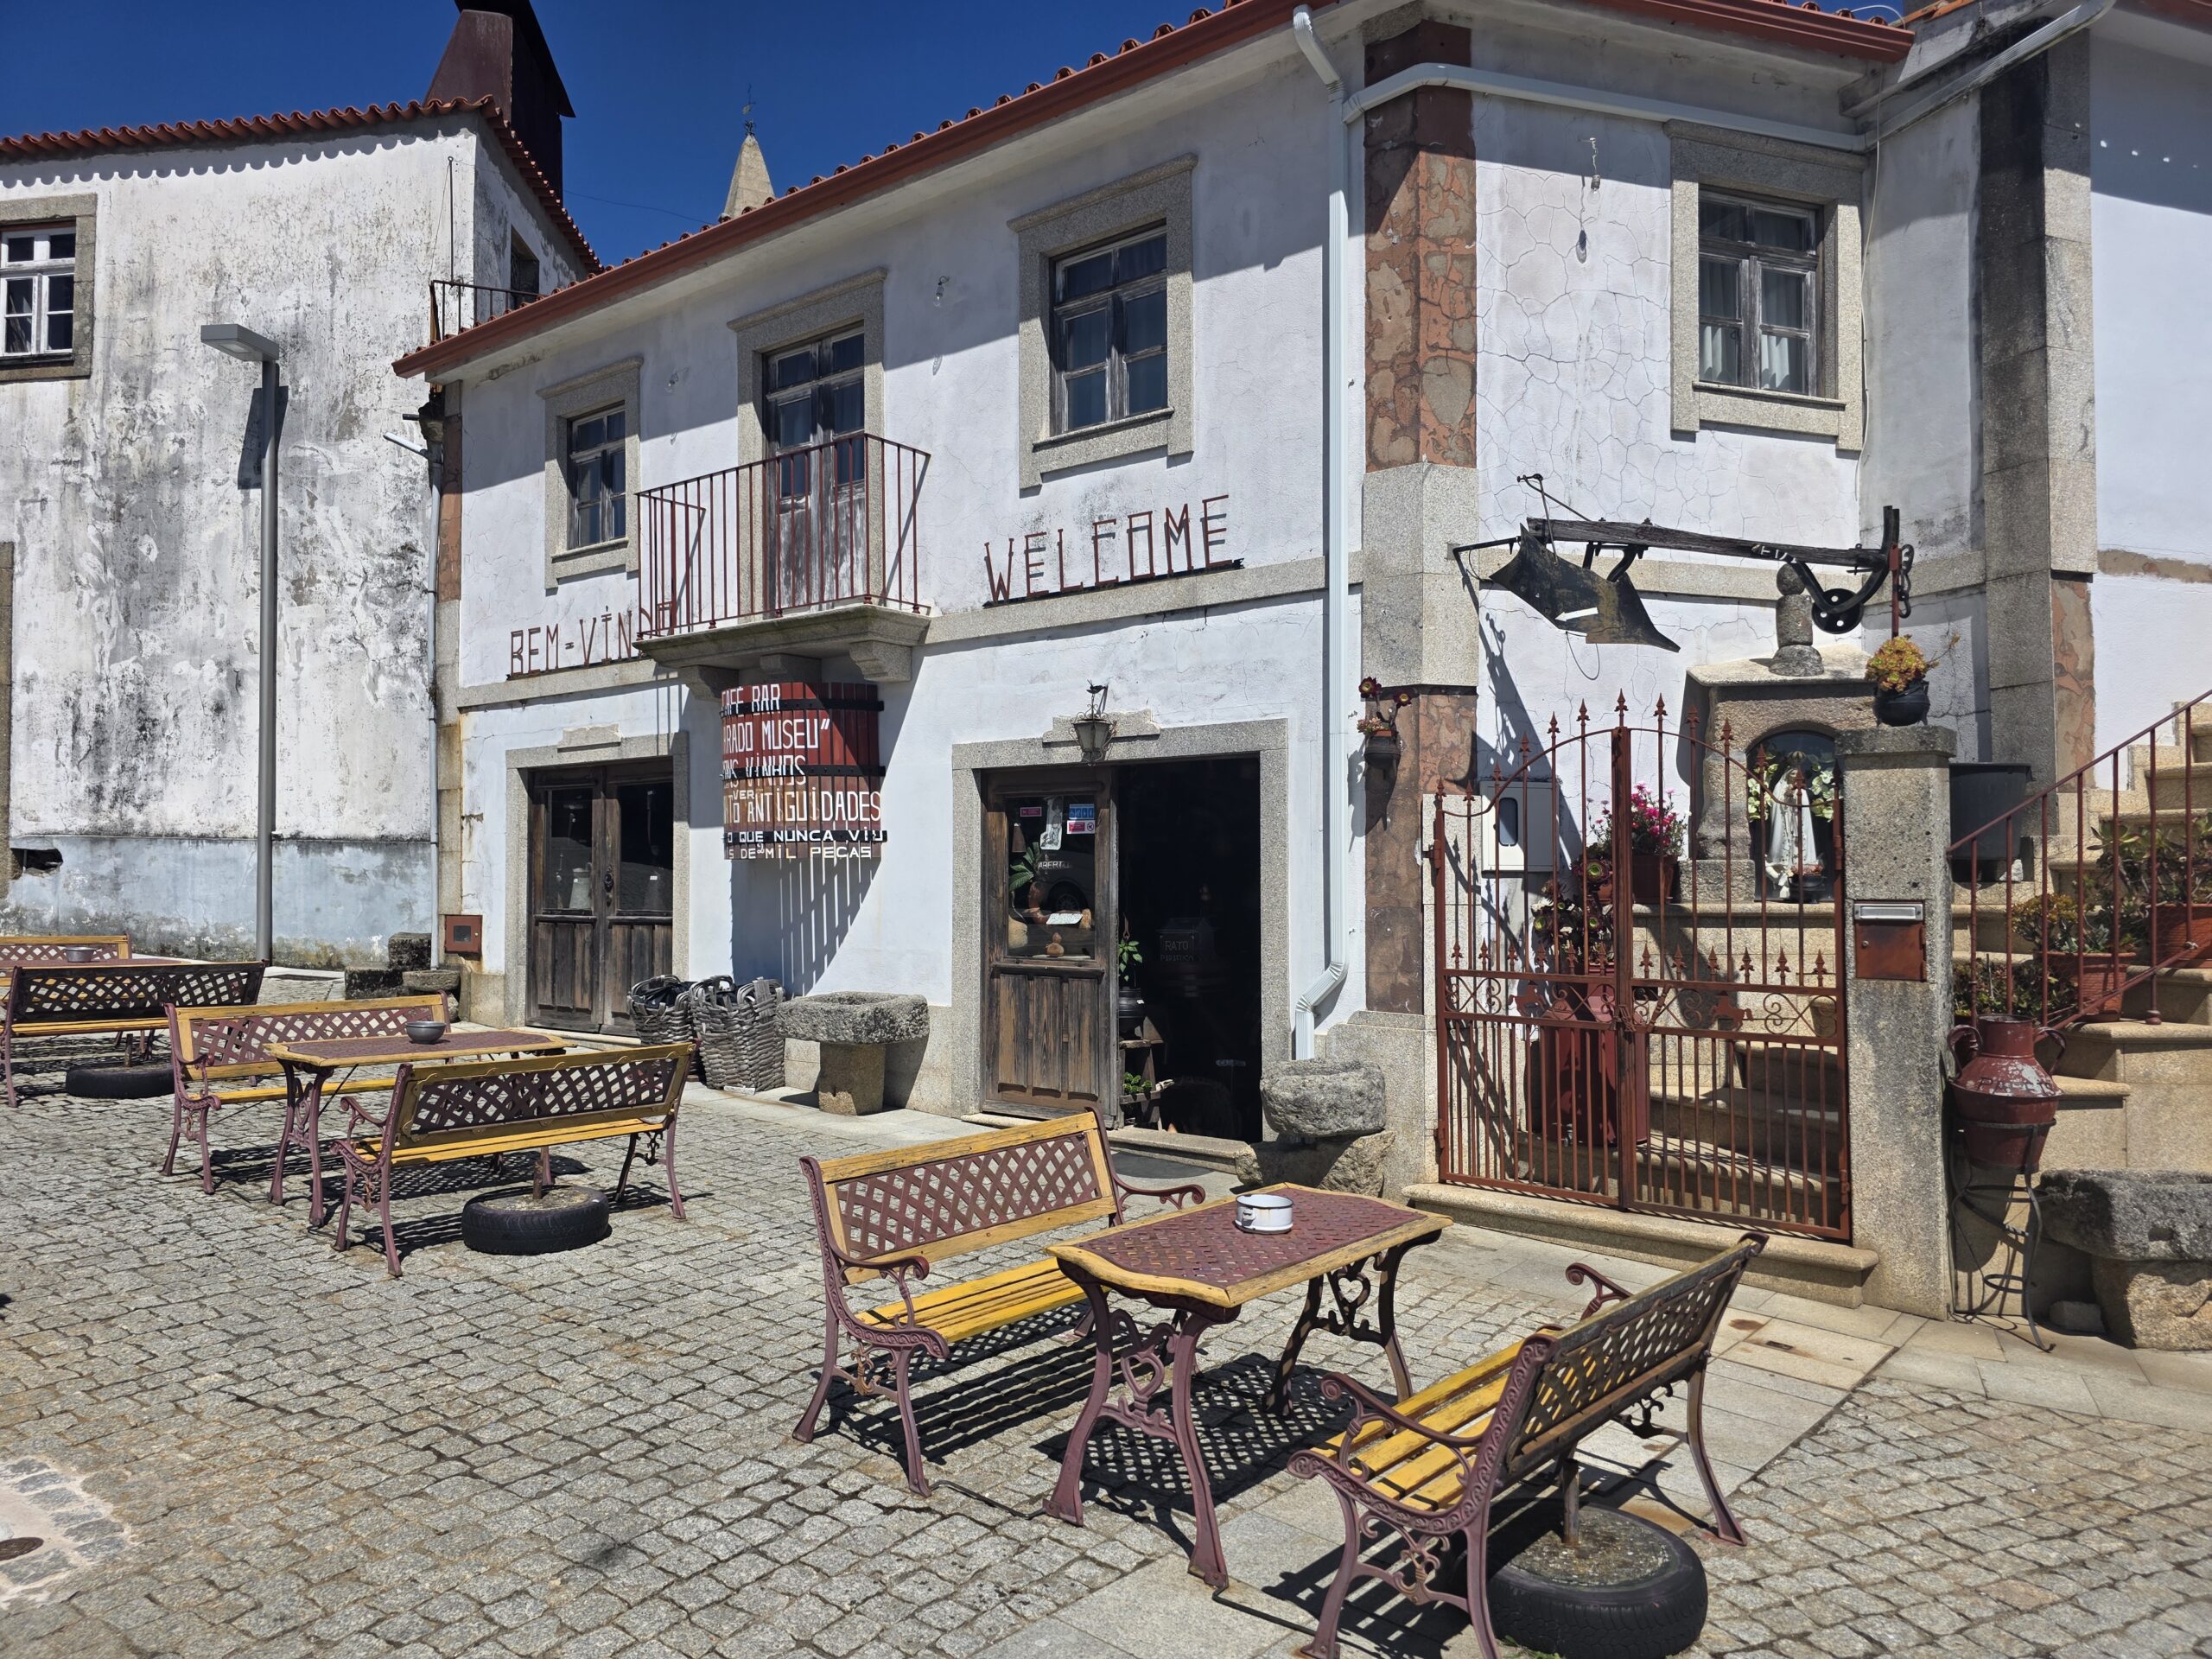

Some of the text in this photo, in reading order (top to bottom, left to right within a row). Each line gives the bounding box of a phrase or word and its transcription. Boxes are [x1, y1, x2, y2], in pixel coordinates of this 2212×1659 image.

[984, 495, 1232, 605] WELCOME
[752, 683, 780, 715] BAR
[733, 789, 755, 800] VER
[740, 831, 764, 843] QUE
[774, 830, 834, 843] NUNCA
[741, 848, 756, 859] DE
